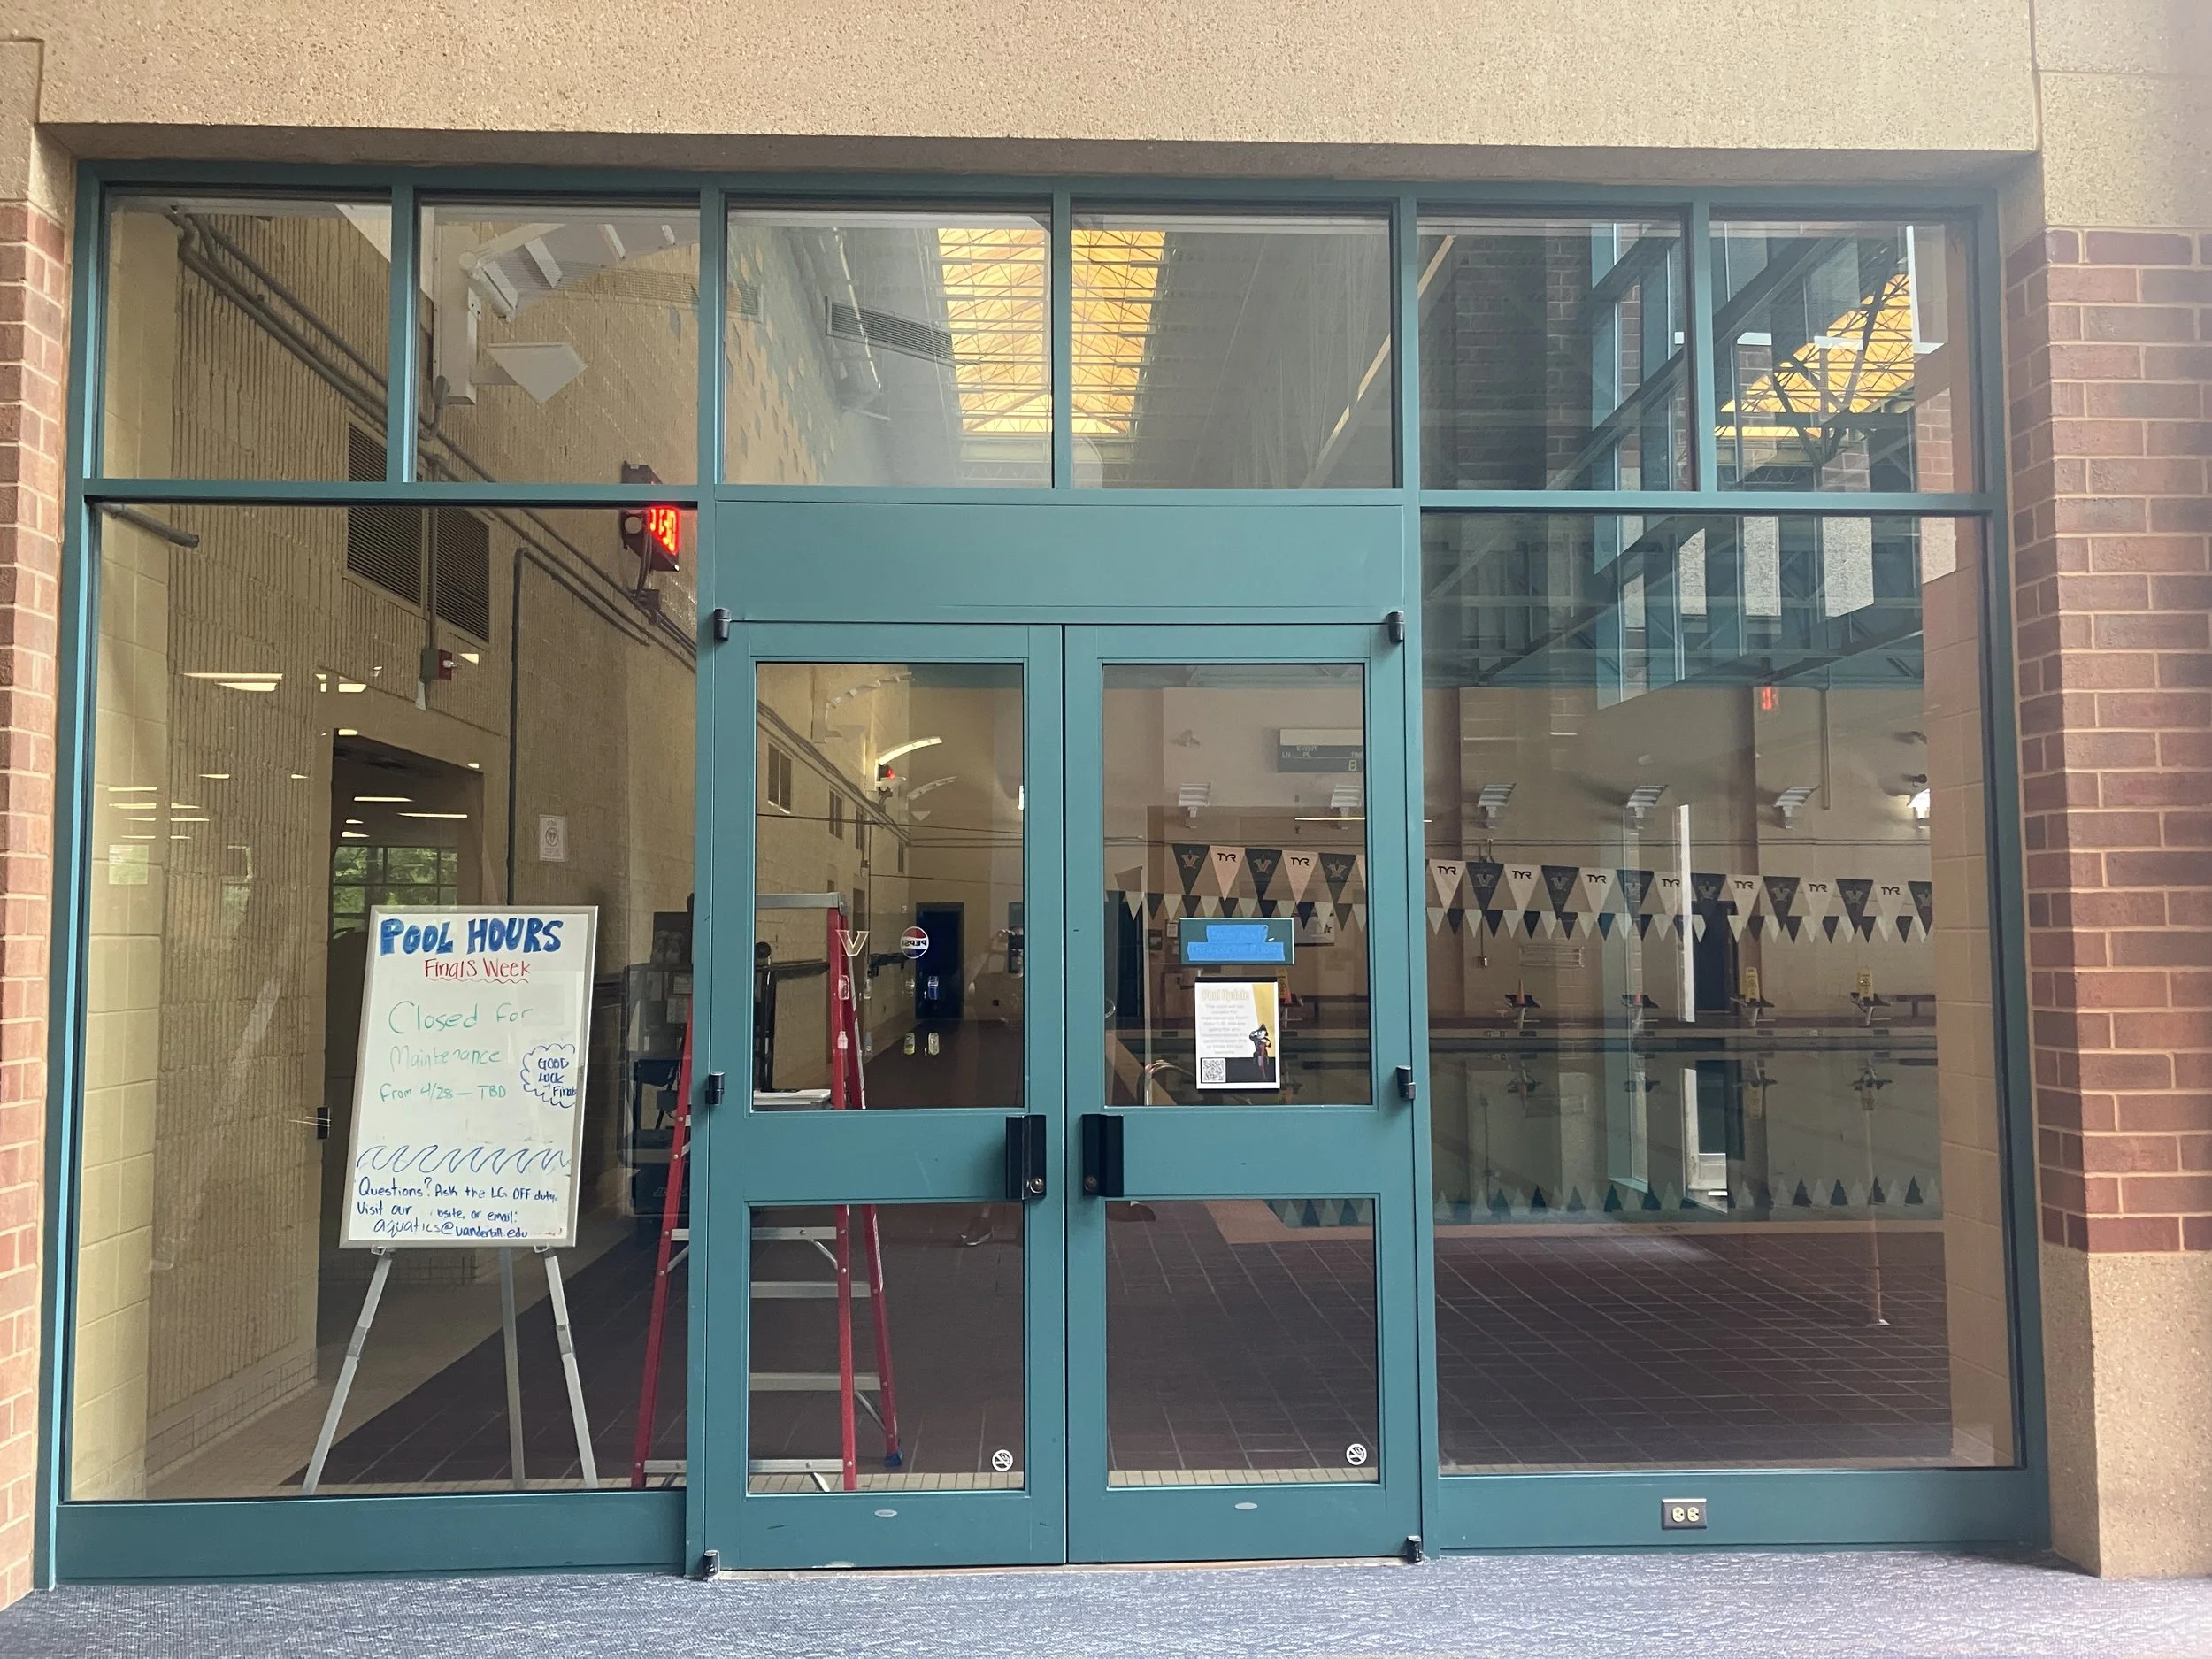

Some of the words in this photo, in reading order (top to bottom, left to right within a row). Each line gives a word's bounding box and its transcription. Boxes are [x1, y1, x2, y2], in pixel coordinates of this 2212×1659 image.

[1217, 853, 1236, 862] TYR
[1291, 857, 1310, 866] TYR
[1437, 866, 1457, 875] TYR
[1512, 870, 1532, 879] TYR
[1587, 874, 1607, 884] TYR
[1662, 879, 1680, 887] TYR
[1809, 884, 1828, 893] TYR
[1881, 887, 1901, 895] TYR
[380, 918, 454, 956] POOL
[466, 918, 564, 955] HOURS
[483, 958, 531, 978] Week
[388, 1001, 478, 1034] Closed
[390, 1044, 503, 1073] Maintenance
[538, 1057, 569, 1071] GOOD
[538, 1072, 565, 1084] LUCK
[419, 1082, 453, 1100] 4/28
[476, 1084, 507, 1100] TBD
[358, 1177, 433, 1198] Questions?
[434, 1183, 458, 1197] Ask
[465, 1185, 486, 1198] the
[512, 1187, 531, 1201] OFF
[357, 1199, 384, 1216] Visit
[391, 1204, 413, 1217] our
[471, 1210, 482, 1219] or
[488, 1210, 518, 1224] email:
